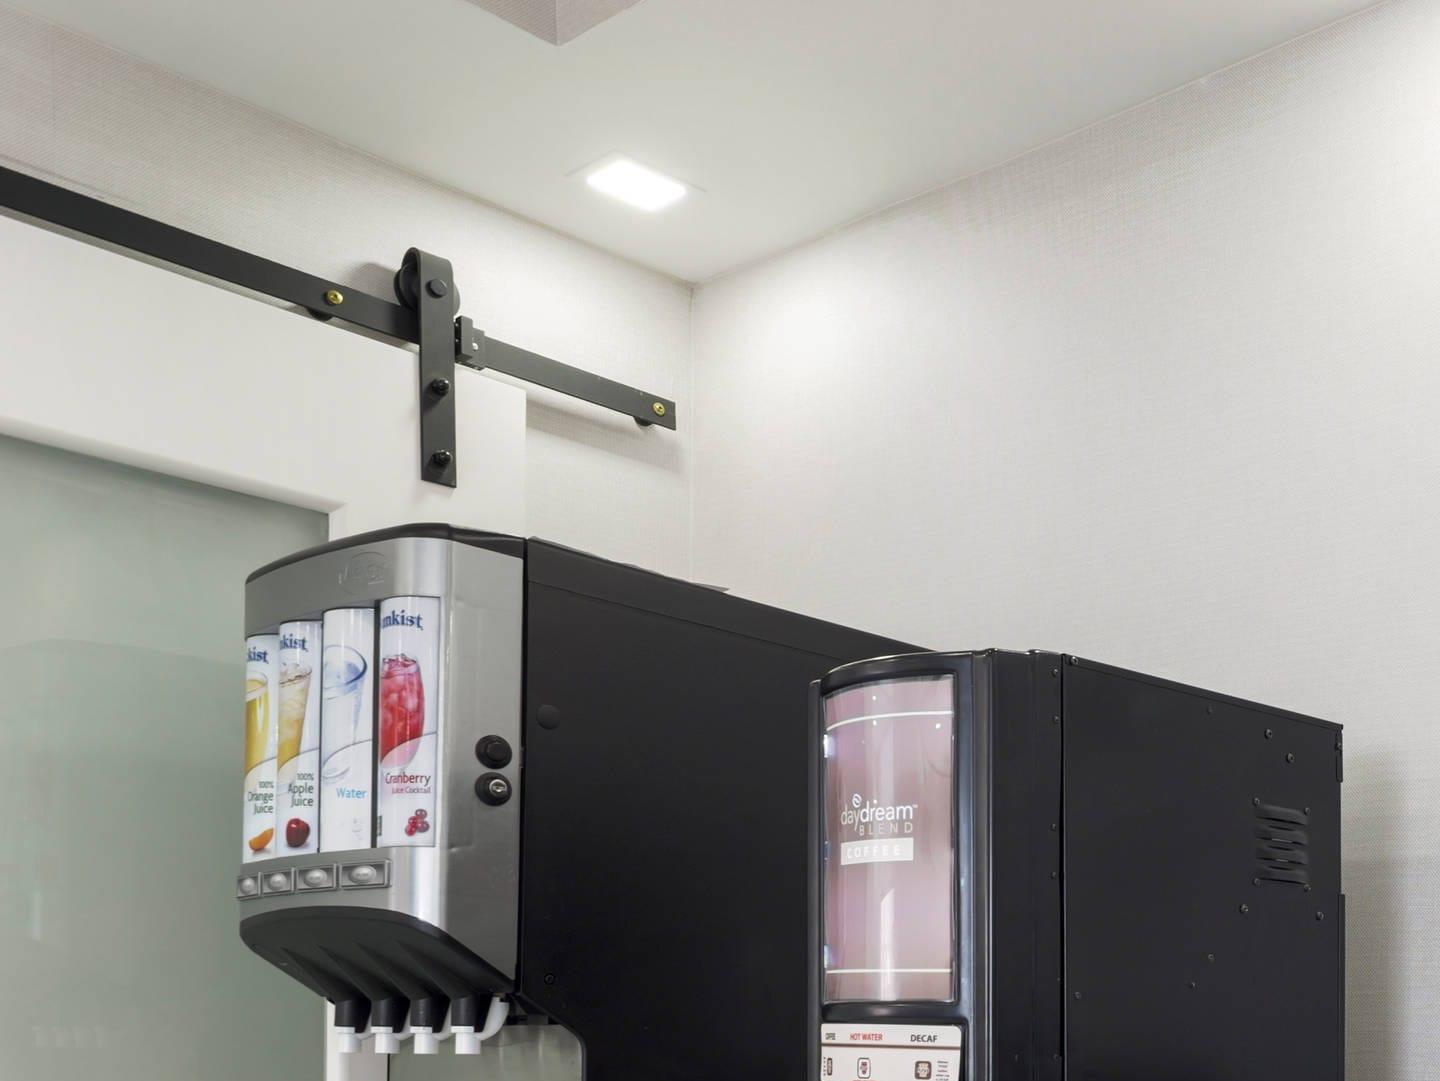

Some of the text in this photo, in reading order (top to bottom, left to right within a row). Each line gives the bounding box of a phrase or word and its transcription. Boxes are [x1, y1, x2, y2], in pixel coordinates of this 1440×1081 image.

[385, 772, 431, 787] Cranberry
[288, 782, 314, 798] Apple
[336, 787, 367, 799] Water
[248, 791, 274, 804] Orange
[291, 794, 314, 808] Juice
[253, 803, 274, 815] Juice
[859, 822, 913, 836] BLEND
[846, 844, 901, 859] COFFEE
[849, 1033, 861, 1041] HOT
[862, 1033, 883, 1041] WATER
[910, 1034, 938, 1043] DECAF
